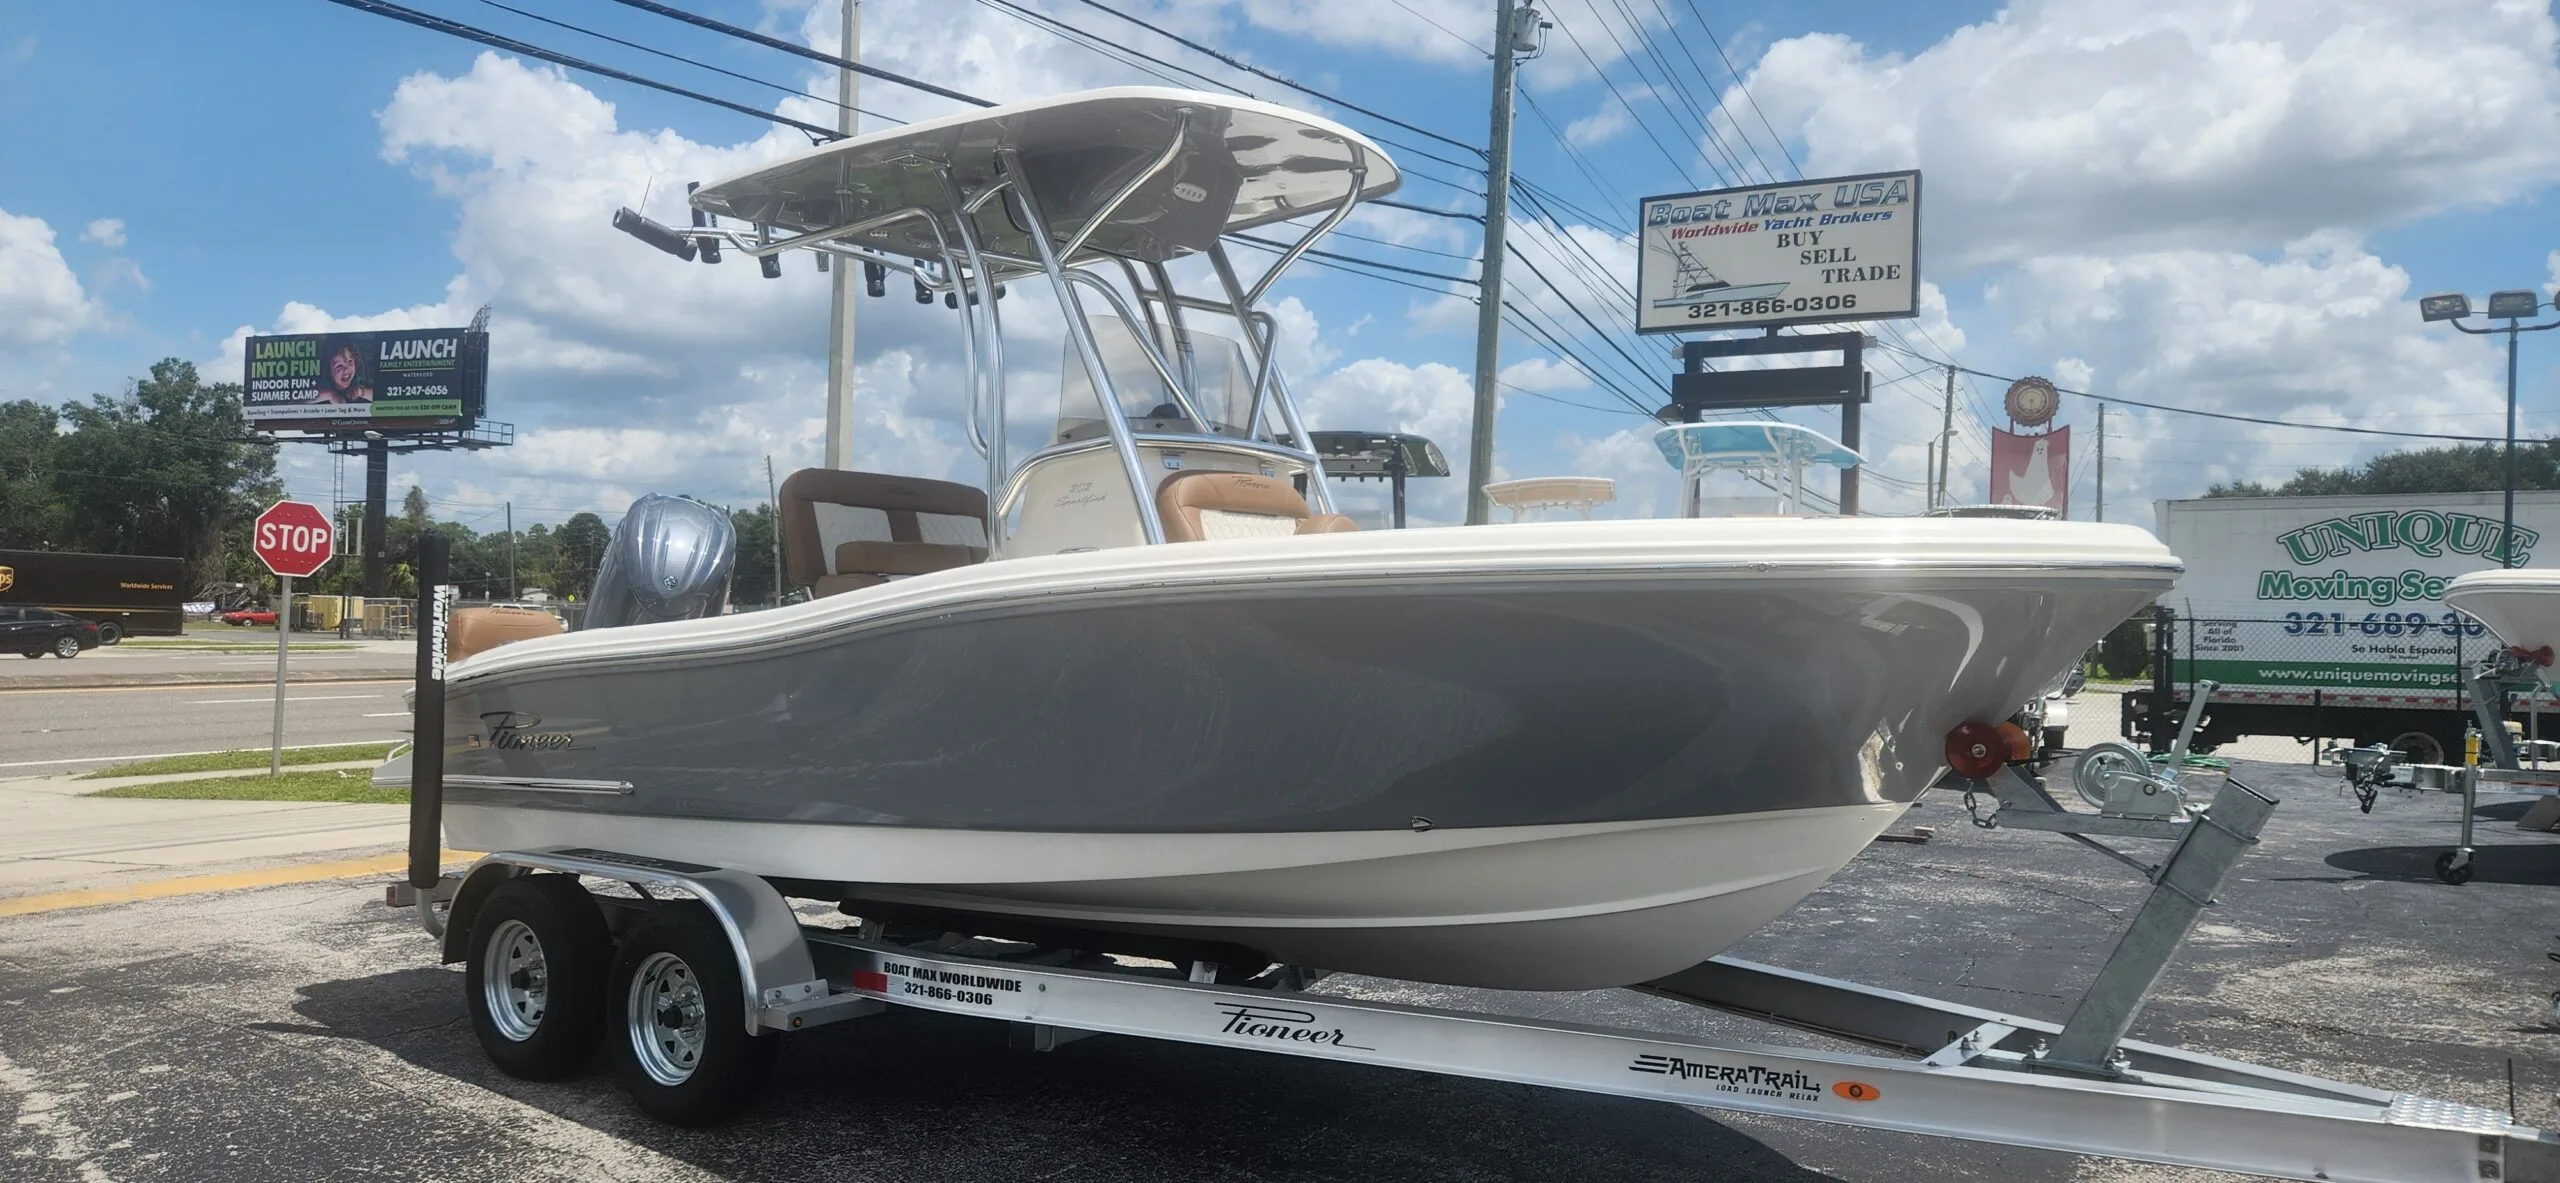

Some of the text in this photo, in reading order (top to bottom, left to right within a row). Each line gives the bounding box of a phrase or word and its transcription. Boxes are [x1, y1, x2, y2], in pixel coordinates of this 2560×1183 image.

[1648, 179, 1909, 227] Boat Max USA
[1671, 211, 1893, 239] Worldwide Yacht Brokers
[1777, 230, 1823, 248] BUY
[1800, 247, 1856, 265] SELL
[1822, 264, 1900, 284] TRADE
[1688, 294, 1857, 319] 321-866-0306
[256, 340, 317, 359] LAUNCH
[380, 338, 457, 360] LAUNCH
[251, 359, 320, 378] INTO FUN
[380, 359, 455, 368] FAMILY ENTERTAINMENT
[252, 379, 290, 390] INDOOR
[291, 378, 310, 389] FUN
[387, 385, 448, 396] 321-247-6056
[251, 390, 319, 402] SUMMER CAMP
[260, 522, 328, 553] STOP
[2276, 510, 2540, 568] UNIQUE
[0, 573, 12, 588] ps
[2257, 570, 2398, 606] Moving
[431, 584, 446, 680] Worldwide
[2351, 644, 2458, 656] Se Habla Español
[2258, 667, 2464, 685] www.uniquemovingse
[480, 711, 597, 751] Pioneer
[884, 962, 1022, 993] BOAT MAX WORLDWIDE
[904, 981, 993, 1005] 321-866-0306
[1215, 1001, 1376, 1051] Pioneer
[1716, 1084, 1819, 1102] LOAD LAUNCH RELAX
